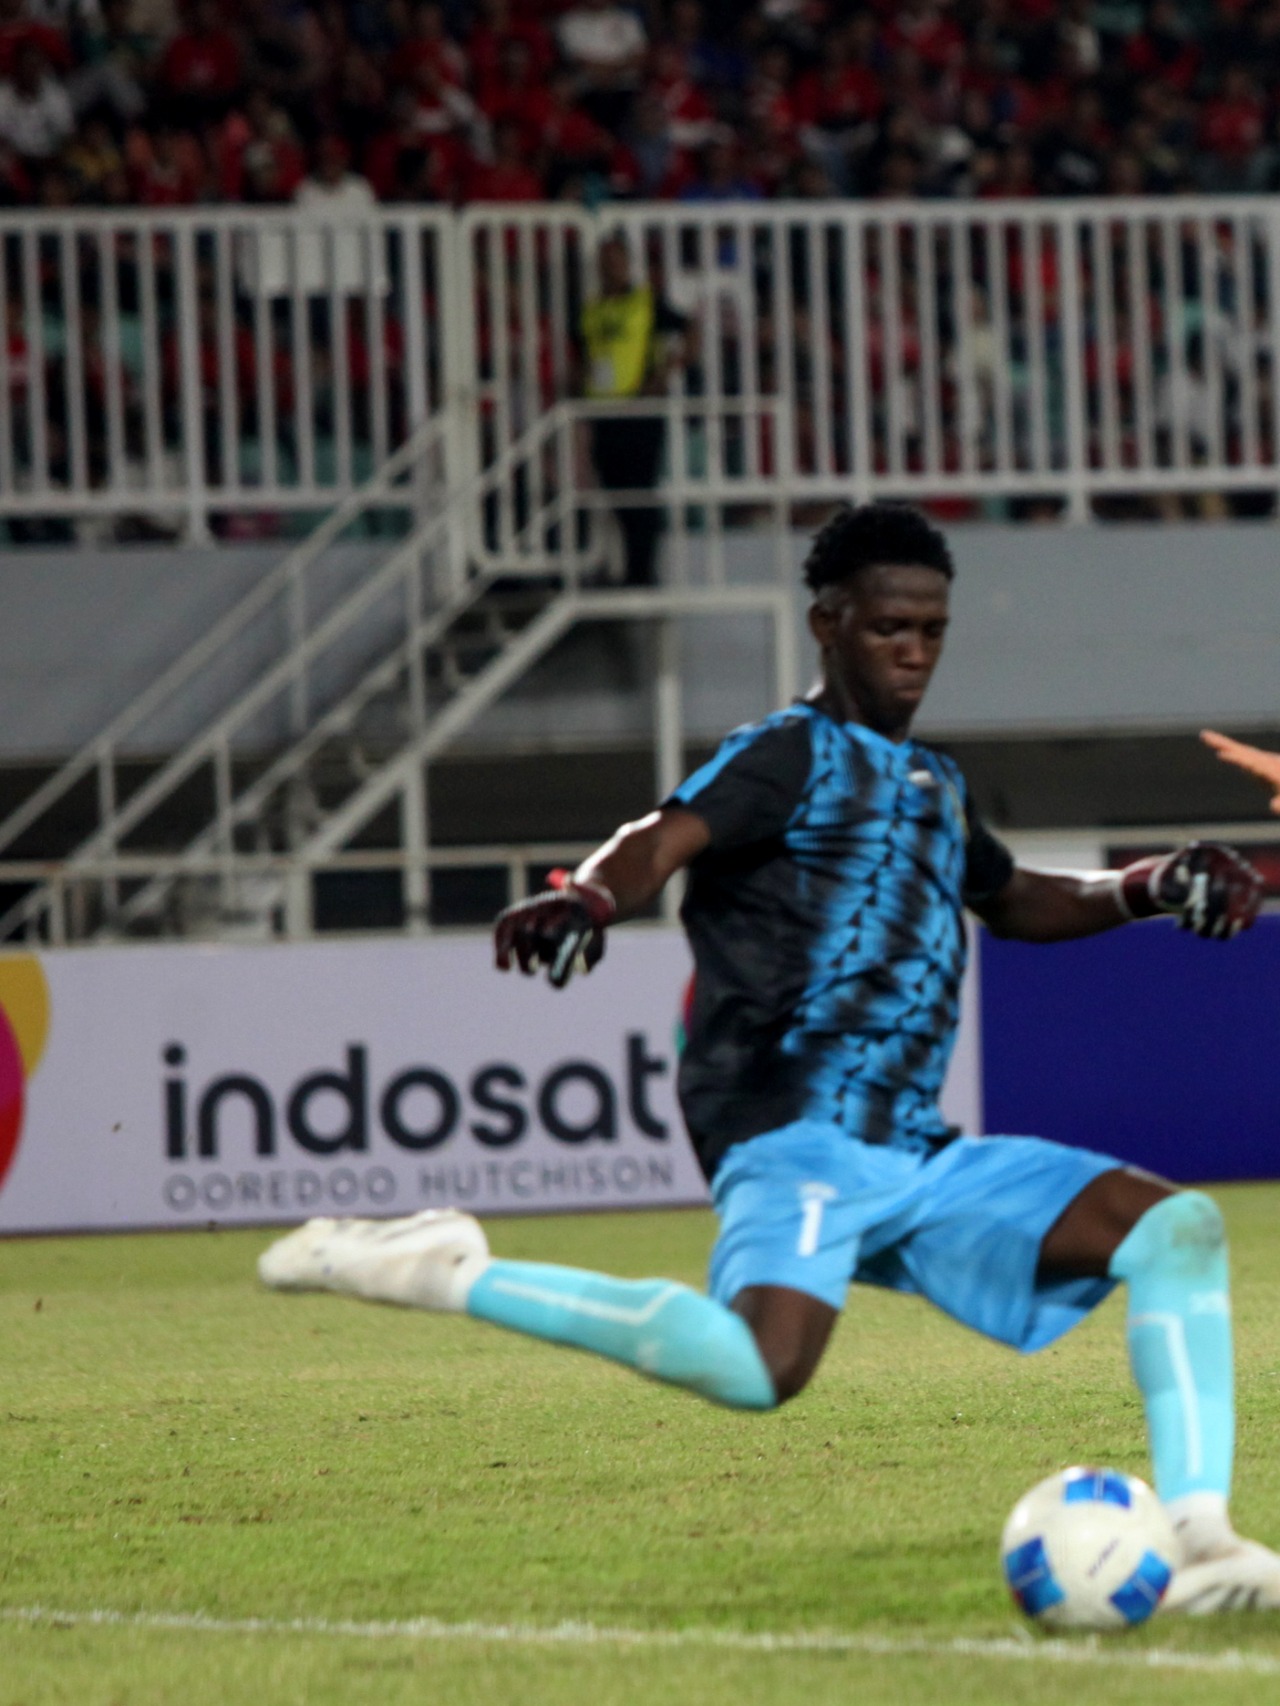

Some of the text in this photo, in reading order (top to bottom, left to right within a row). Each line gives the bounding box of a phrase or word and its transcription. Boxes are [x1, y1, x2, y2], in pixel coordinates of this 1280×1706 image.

[163, 1032, 670, 1161] indosat
[163, 1154, 675, 1213] OOREDOO HUTCHISON
